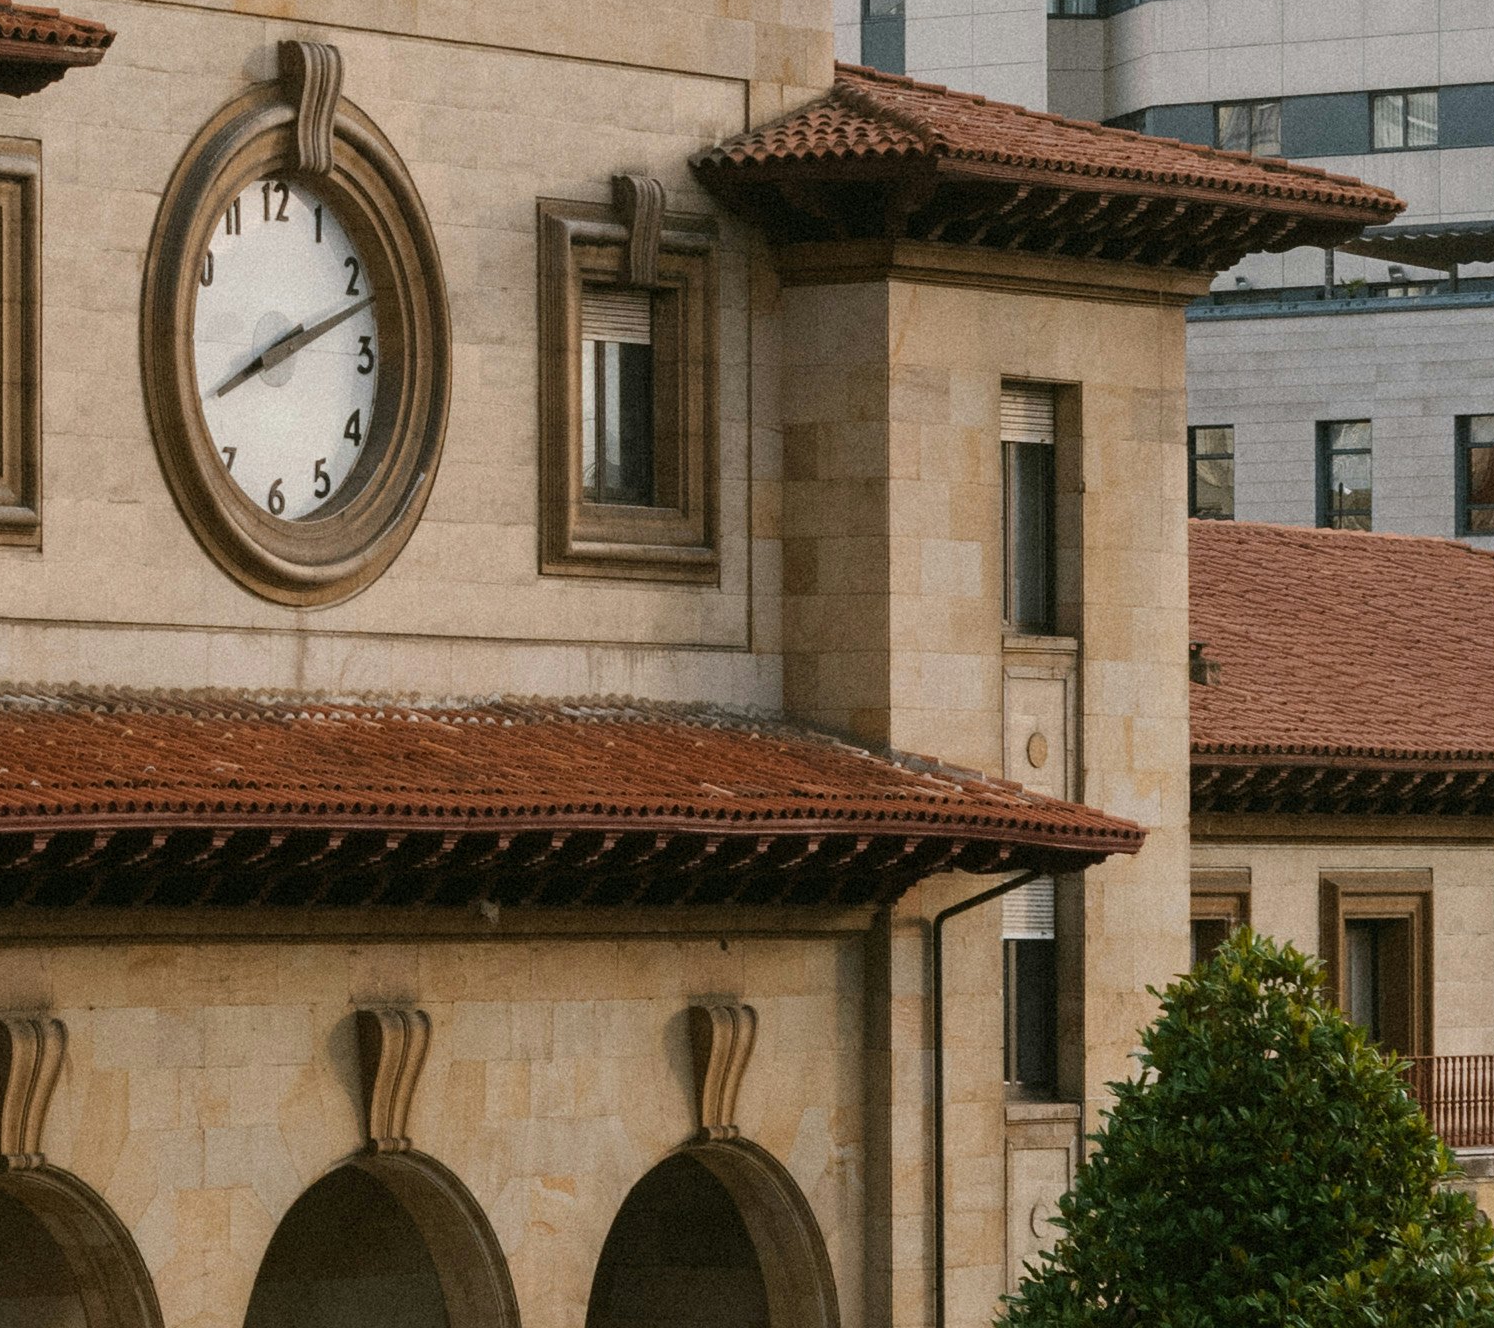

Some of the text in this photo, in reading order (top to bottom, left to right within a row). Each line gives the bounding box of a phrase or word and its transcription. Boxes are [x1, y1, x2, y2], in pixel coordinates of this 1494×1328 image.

[262, 182, 289, 222] 12
[314, 203, 322, 243] 1
[344, 256, 360, 296] 2
[357, 336, 375, 375] 3
[343, 408, 362, 447] 4
[268, 477, 286, 516] 6
[314, 457, 331, 499] 5
